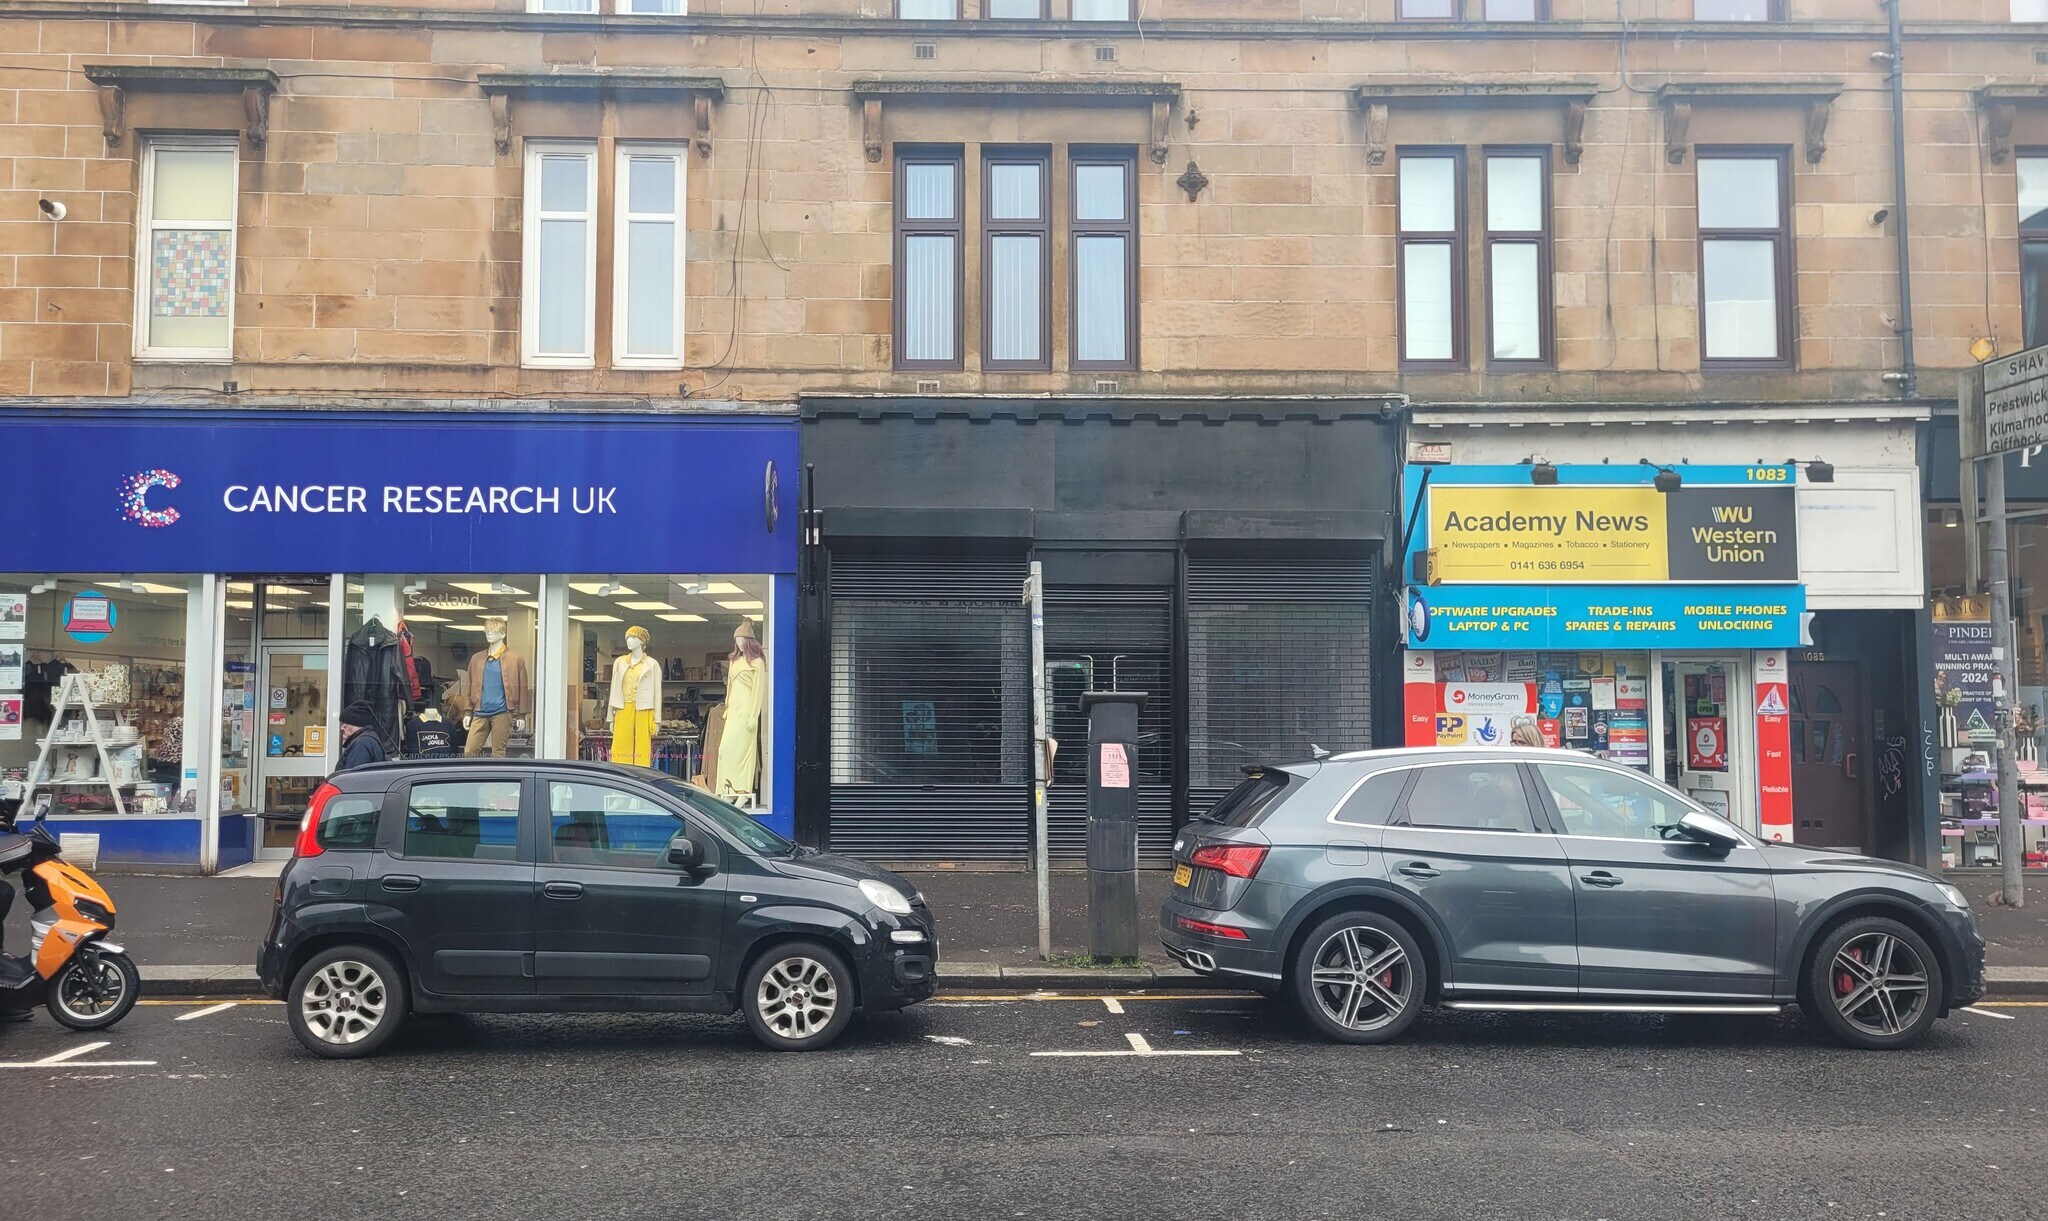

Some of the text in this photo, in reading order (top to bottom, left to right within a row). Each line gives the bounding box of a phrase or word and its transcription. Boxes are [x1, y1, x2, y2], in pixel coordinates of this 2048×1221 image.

[1989, 388, 2048, 416] Prestwick
[1746, 468, 1787, 481] 1083
[222, 485, 617, 514] CANCER RESEARCH UK
[1712, 506, 1753, 523] WU
[1443, 510, 1649, 536] Academy News
[1691, 527, 1777, 544] Western
[1451, 540, 1650, 550] Newspapers Magazines Tobacco Stationery
[1707, 545, 1765, 562] Union
[1510, 561, 1585, 570] 0141 636 6954
[408, 593, 480, 607] Scotland
[1491, 606, 1558, 617] UPGRADES
[1587, 606, 1653, 616] TRADE-INS
[1683, 605, 1788, 615] MOBILE PHONES
[1448, 621, 1530, 631] LAPTOP & PC
[1565, 620, 1676, 631] SPARES & REPAIRS
[1698, 620, 1773, 630] UNLOCKING
[1470, 657, 1496, 666] DAILY
[1803, 652, 1825, 662] 1085
[1944, 653, 1970, 661] MULTI
[1935, 662, 1971, 670] WINNING
[1961, 672, 1989, 683] 2024
[1630, 684, 1643, 693] dpd
[1467, 692, 1519, 702] MoneyGram
[1412, 715, 1429, 723] Easy
[1764, 715, 1781, 723] Easy
[1766, 750, 1782, 758] Fast
[1762, 785, 1789, 793] Reliable
